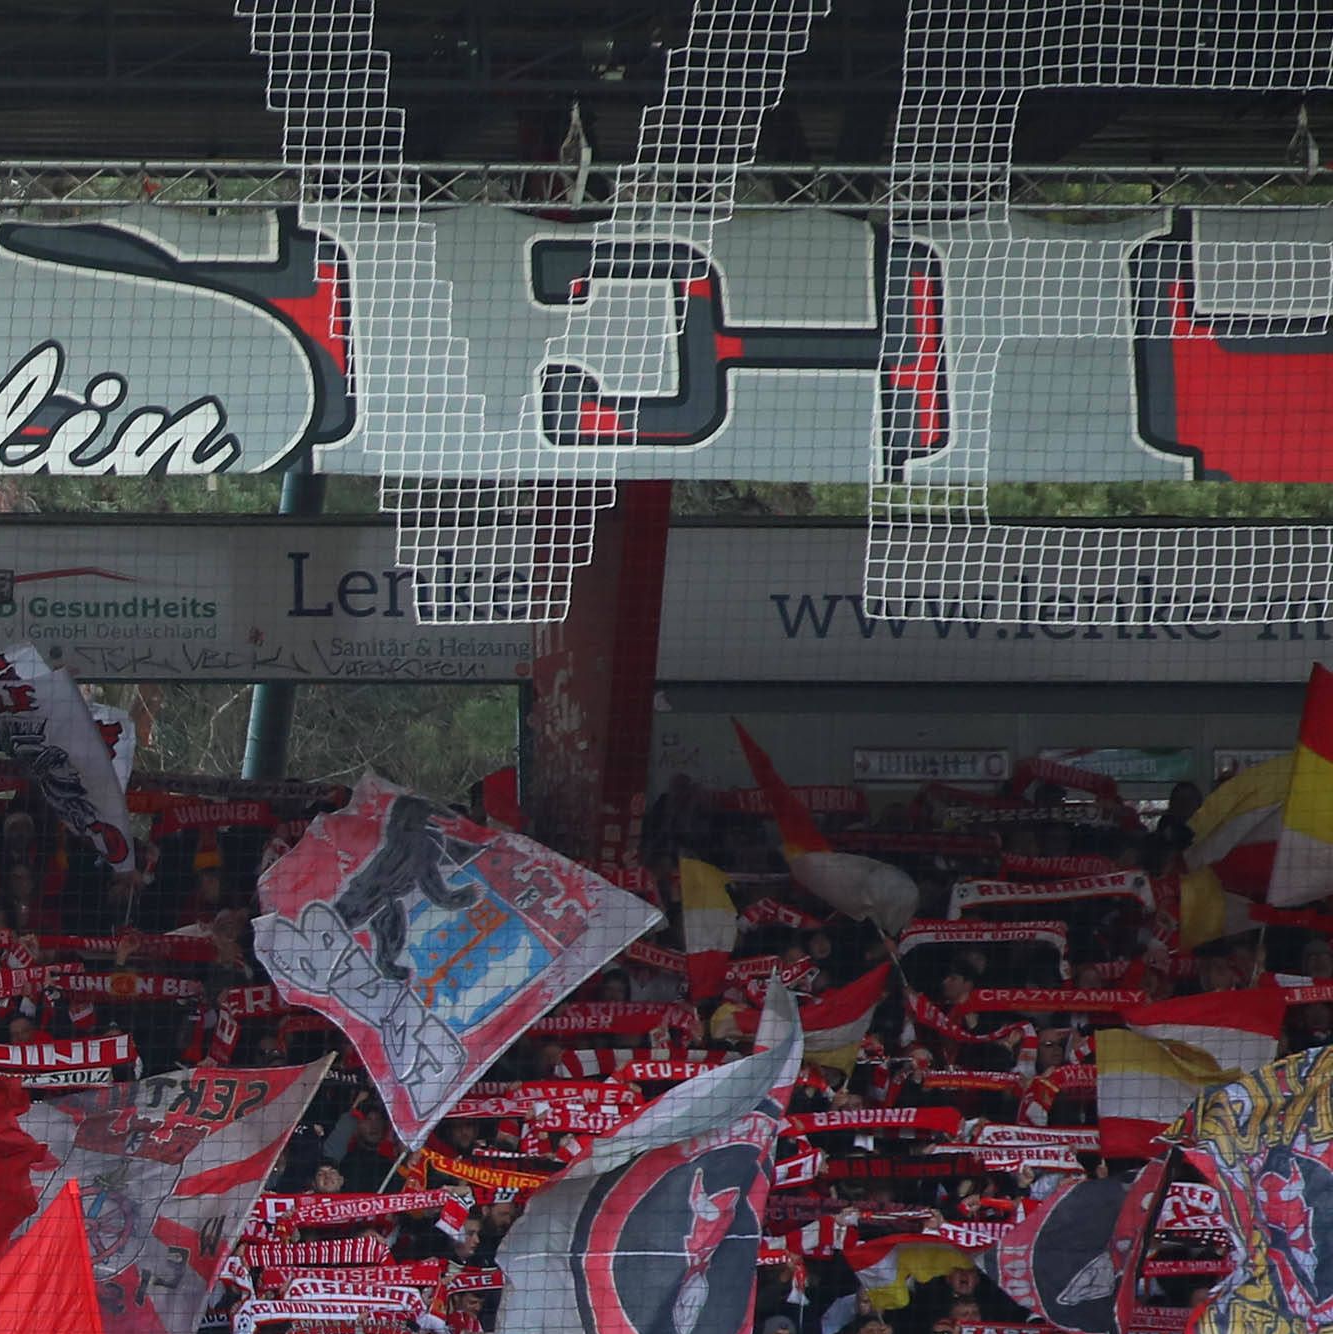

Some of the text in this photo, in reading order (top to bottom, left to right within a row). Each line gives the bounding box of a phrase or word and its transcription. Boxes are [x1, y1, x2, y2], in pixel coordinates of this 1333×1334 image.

[286, 551, 531, 619] Lenke
[28, 597, 218, 620] GesundHeits
[27, 623, 219, 641] GmbH Deutschland
[330, 636, 533, 661] Sanitär & Heizung
[981, 987, 1146, 1004] CRAZYFAMILY
[325, 1199, 382, 1219] UNION
[448, 1273, 493, 1291] ALTE
